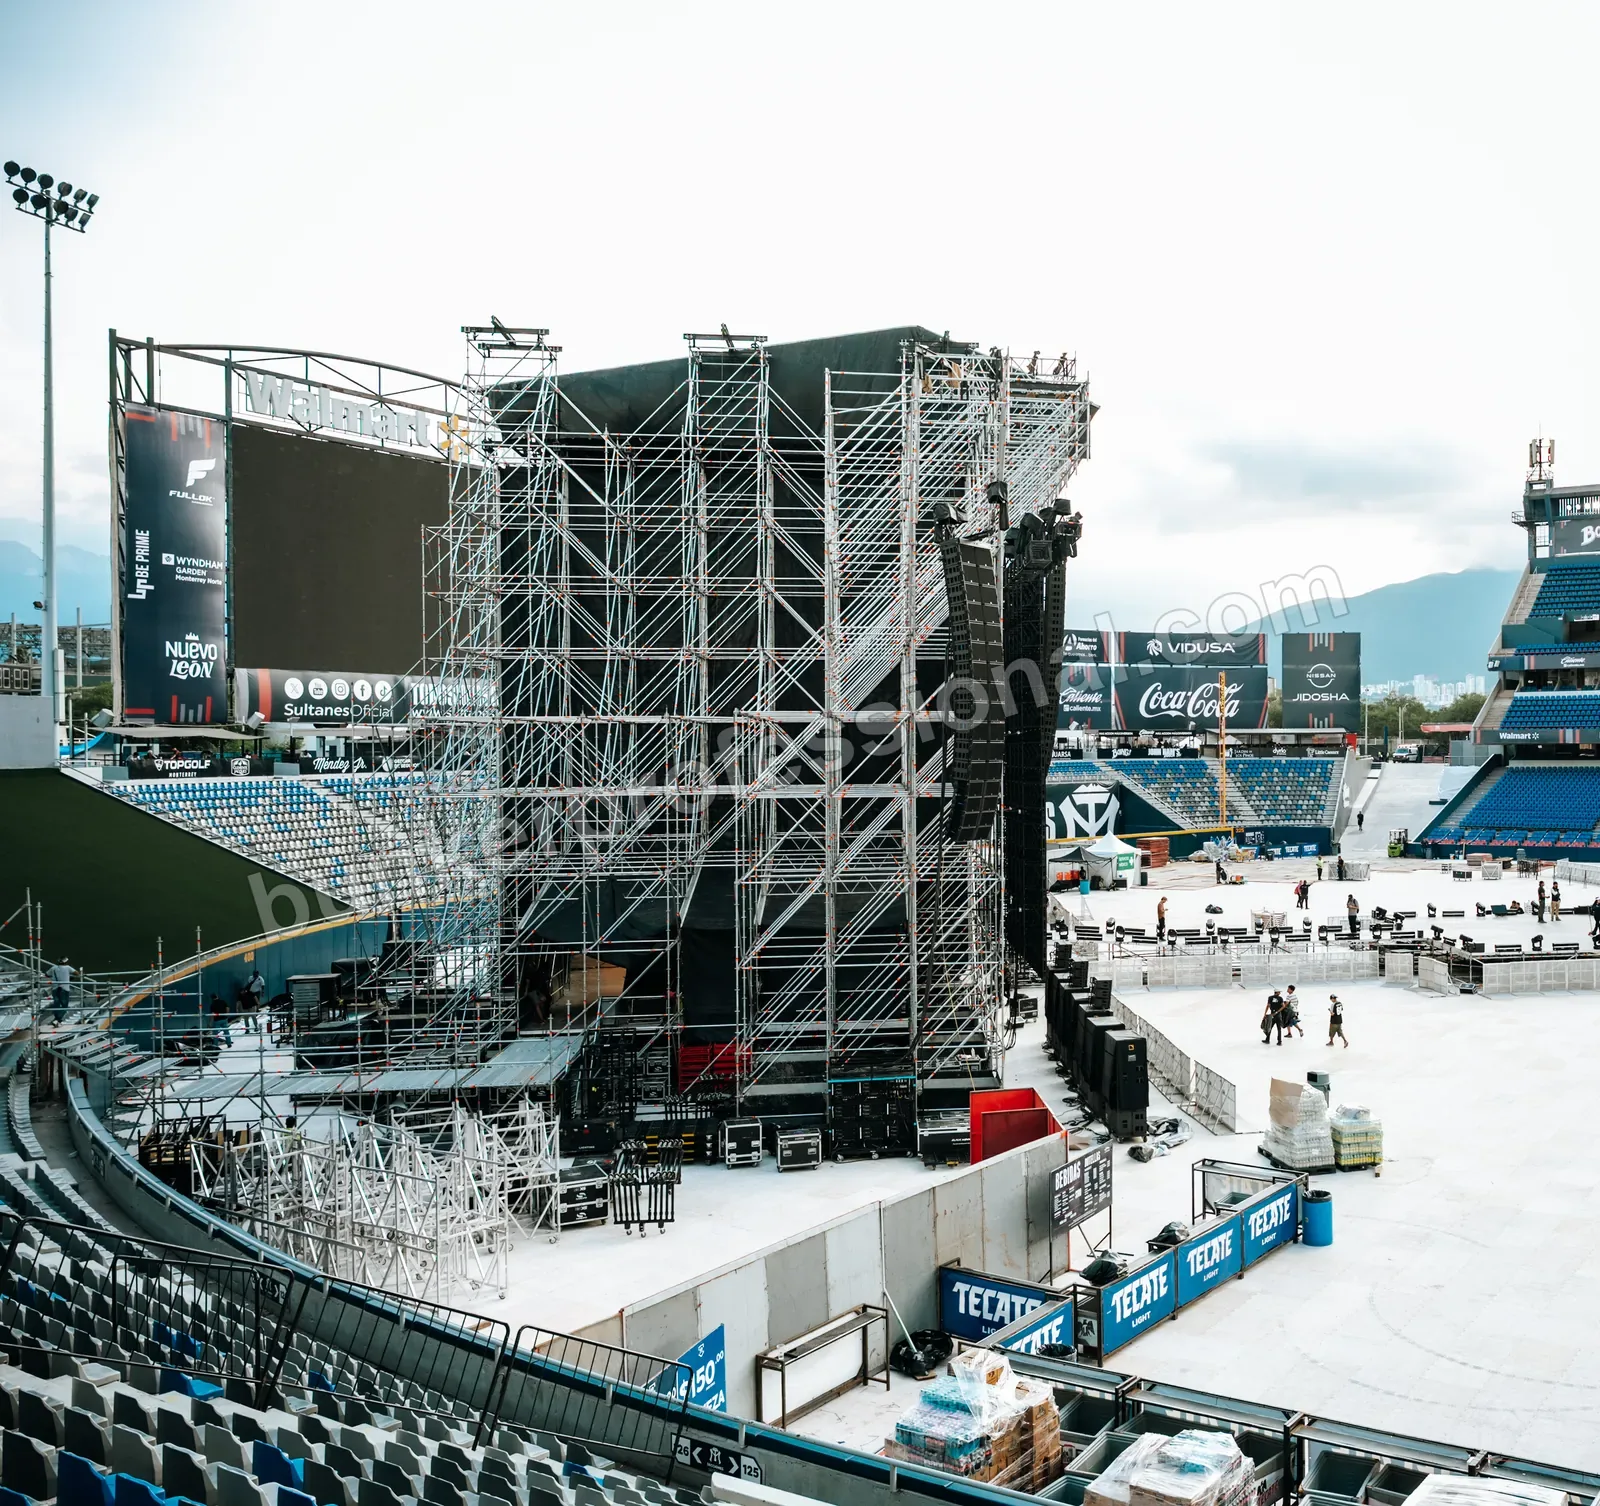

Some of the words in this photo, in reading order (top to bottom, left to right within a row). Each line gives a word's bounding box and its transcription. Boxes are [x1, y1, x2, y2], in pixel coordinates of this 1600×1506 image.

[246, 370, 431, 448] Walmart
[169, 490, 213, 503] FULLOK
[135, 529, 150, 562] PRIME
[176, 556, 223, 570] WYNDHAM
[135, 563, 150, 578] BE
[176, 566, 207, 577] GARDEN
[175, 574, 207, 584] Monterrey
[207, 577, 222, 586] Norte
[1076, 642, 1098, 651] Ahorro
[1167, 642, 1236, 654] VIDUSA
[1139, 682, 1244, 718] Coca-Cola
[1292, 693, 1350, 702] JIDOSHA
[1500, 732, 1531, 740] Walmart
[164, 759, 210, 770] TOPGOLF
[312, 755, 350, 774] Méndez
[1055, 1161, 1081, 1191] BEBIDAS
[1248, 1193, 1292, 1240] TECATE
[1261, 1232, 1277, 1246] LIGHT
[1186, 1228, 1234, 1277] TECATE
[1203, 1268, 1219, 1282] LIGHT
[1111, 1262, 1169, 1324] TECATE
[1131, 1310, 1152, 1328] LIGHT
[982, 1325, 998, 1335] LIG
[676, 1443, 690, 1457] 26
[742, 1464, 759, 1478] 125
